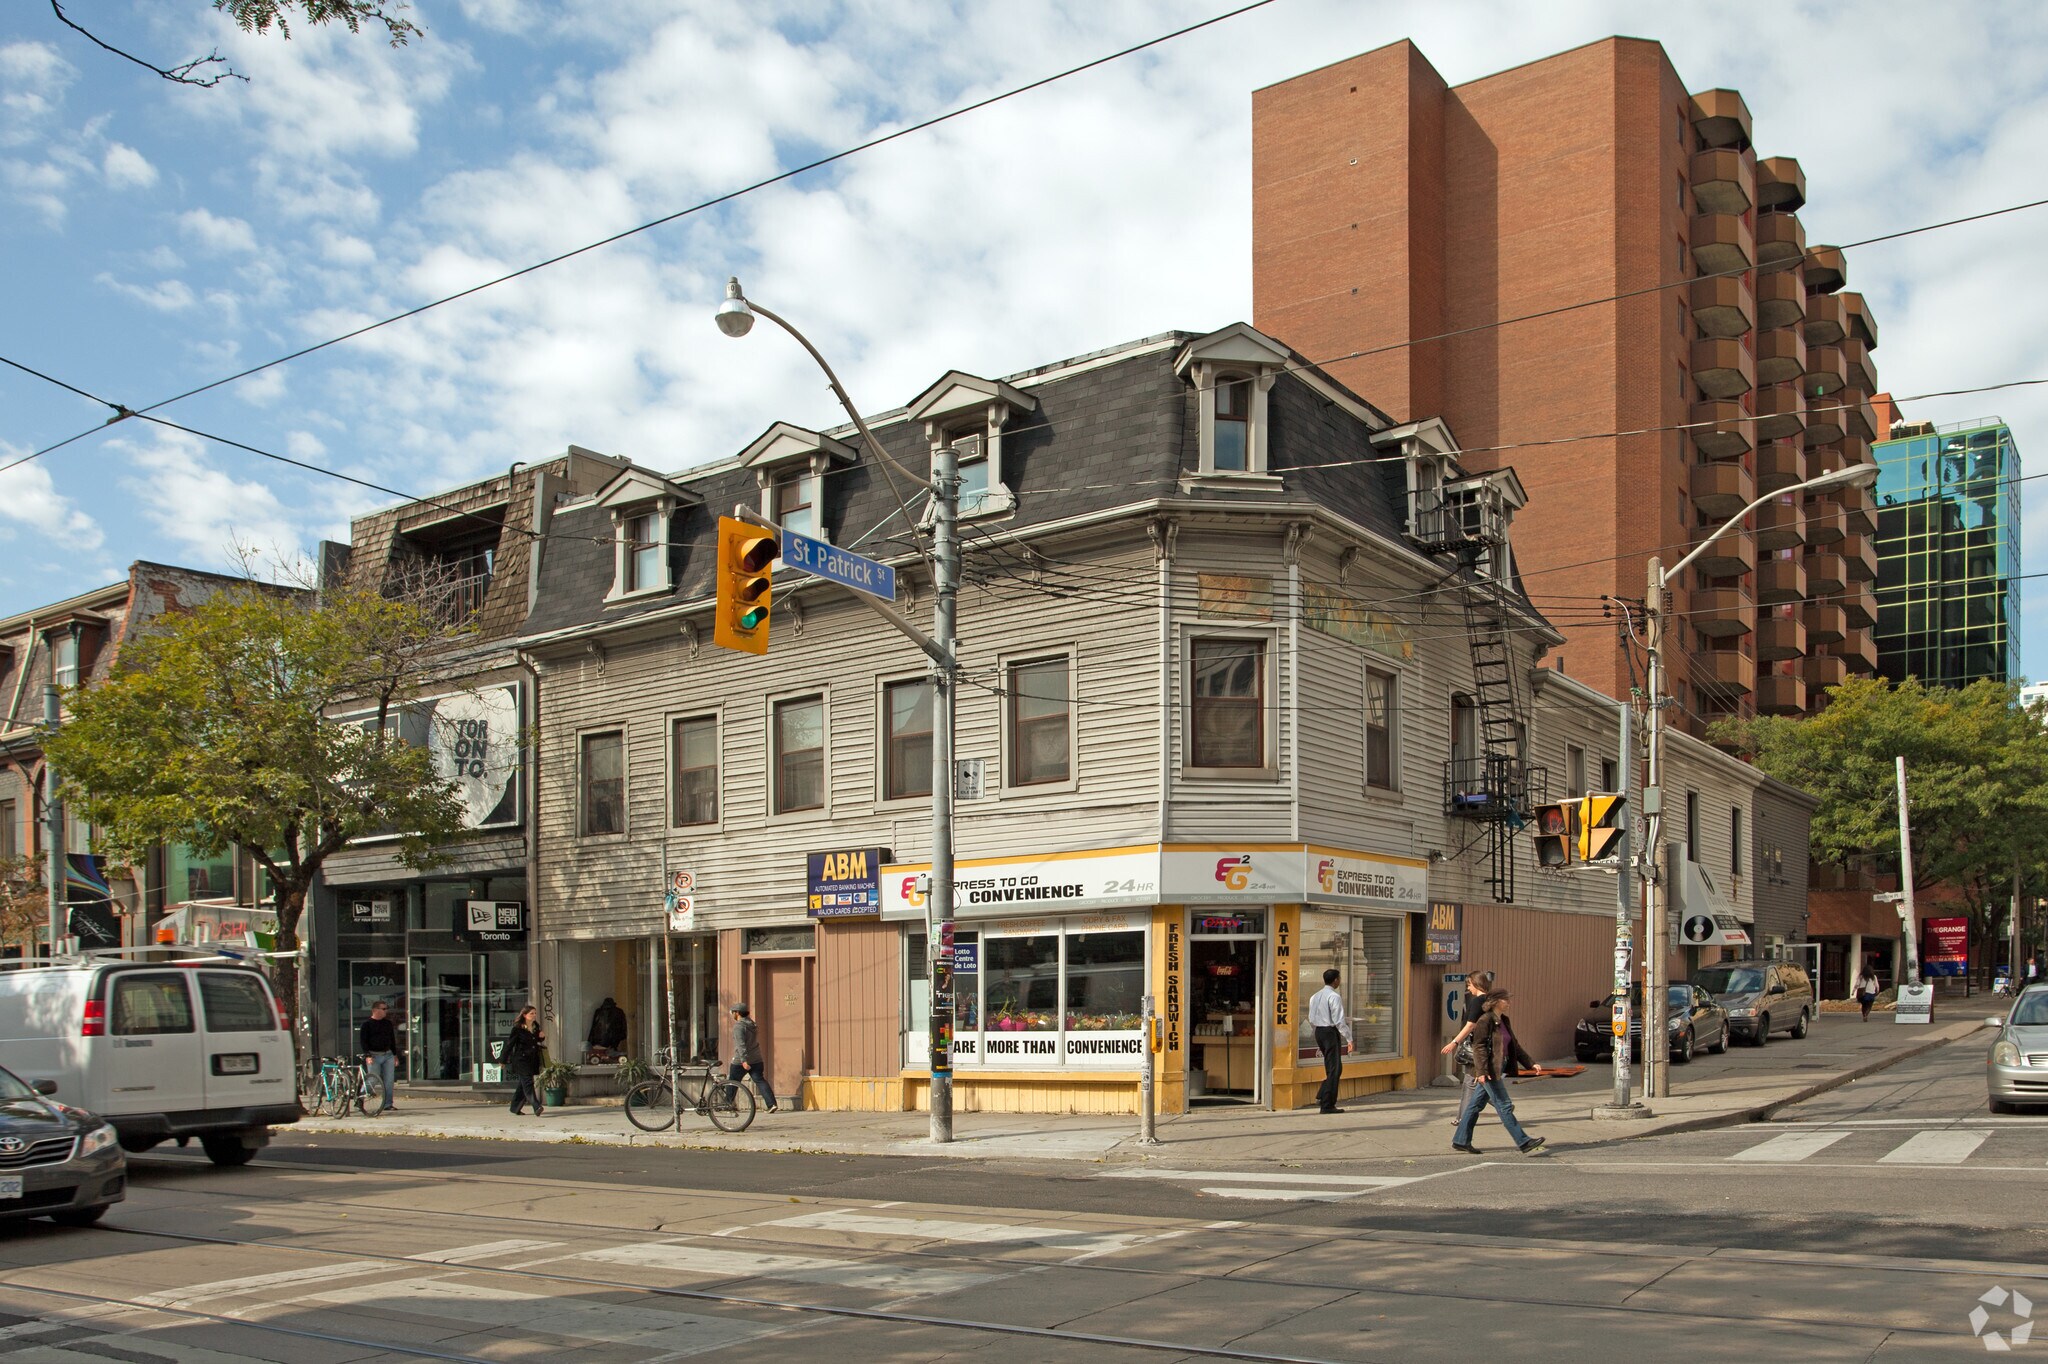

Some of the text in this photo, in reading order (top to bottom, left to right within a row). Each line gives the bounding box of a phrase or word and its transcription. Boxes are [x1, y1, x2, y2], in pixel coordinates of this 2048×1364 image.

[793, 538, 885, 585] St Patrick St
[457, 719, 488, 738] TOR
[455, 739, 487, 759] ON
[822, 851, 867, 881] ABM
[954, 875, 1038, 891] PRESS TO GO
[1337, 870, 1395, 885] EXPRESS TO GO
[969, 884, 1084, 904] CONVENIENCE
[1338, 881, 1394, 899] CONVENIENCE
[498, 908, 517, 916] NEW
[498, 916, 517, 925] ERA
[1431, 904, 1455, 930] ABM
[480, 932, 510, 940] Toronto
[1277, 922, 1289, 957] ATM
[1168, 924, 1179, 971] FRESH
[1277, 970, 1288, 1025] SNACK
[953, 1039, 1142, 1054] ARE MORE THAN CONVENIENCE
